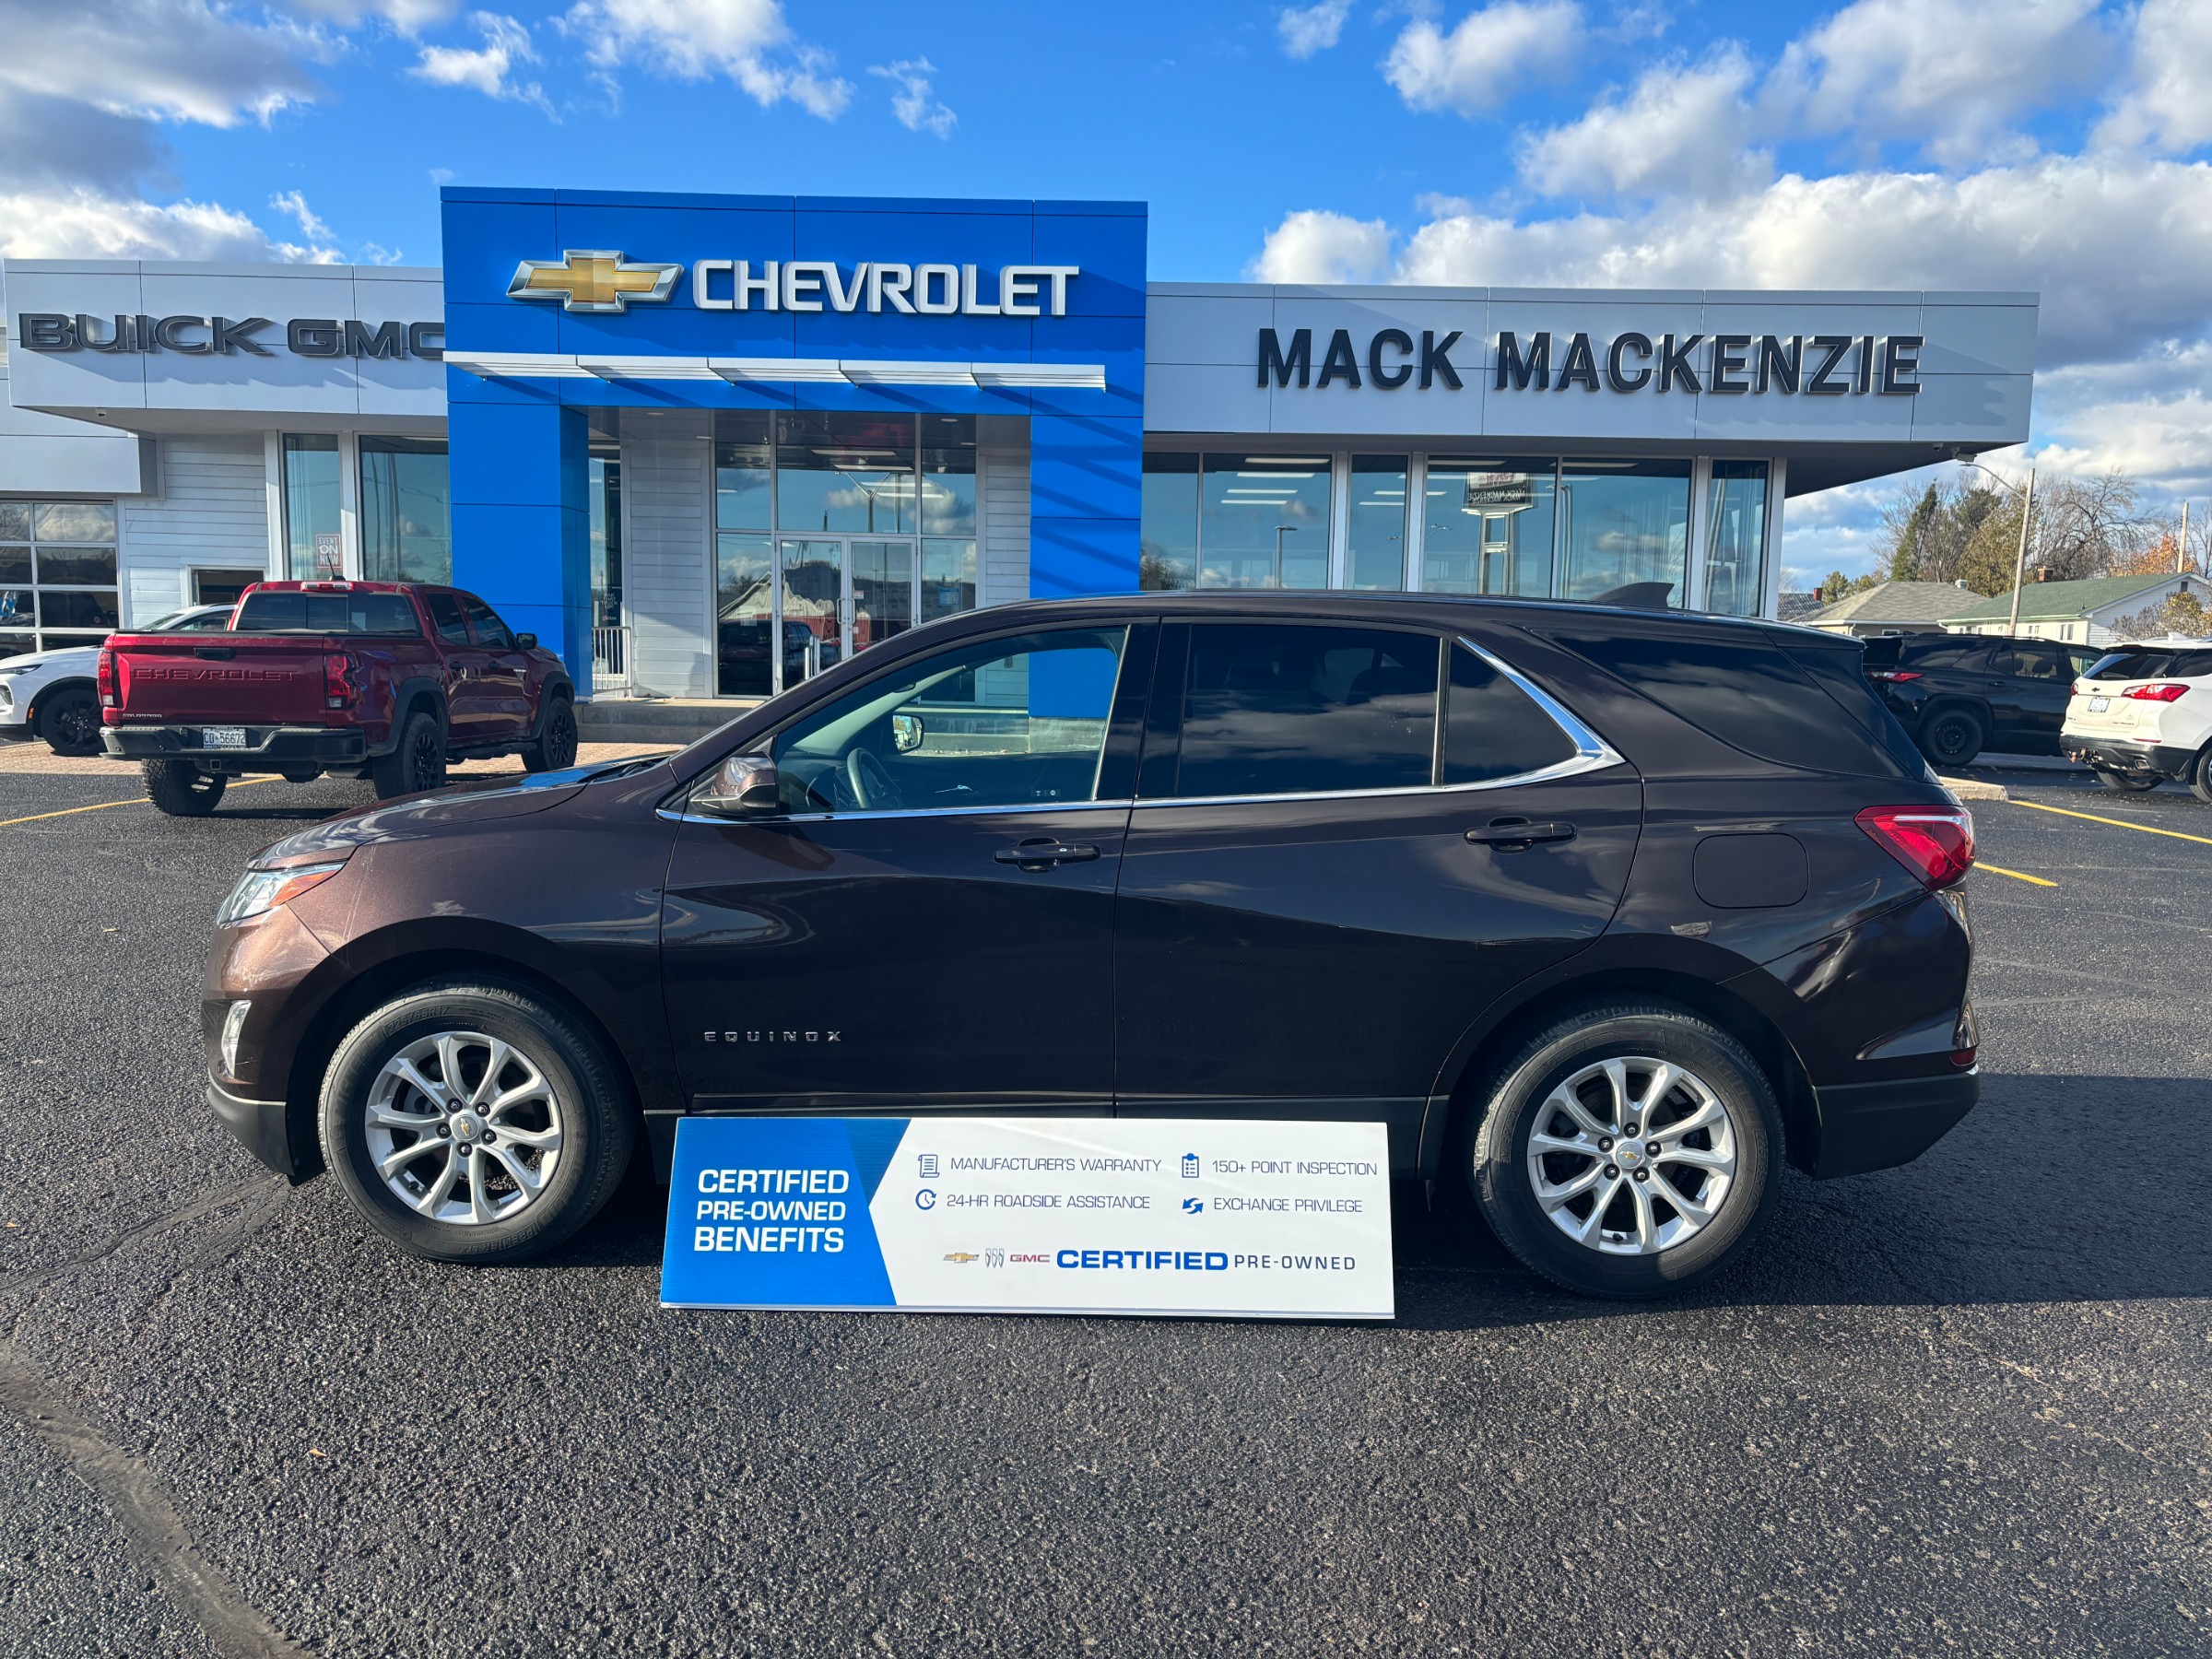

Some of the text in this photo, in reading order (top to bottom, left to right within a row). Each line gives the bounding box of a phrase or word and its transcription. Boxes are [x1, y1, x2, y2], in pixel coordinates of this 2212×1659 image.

[693, 259, 1080, 316] CHEVROLET
[18, 312, 275, 354] BUICK
[1256, 327, 1924, 395] MACK MACKENZIE
[319, 545, 338, 554] ON
[133, 668, 298, 681] CHEVROLET
[703, 1030, 841, 1042] EQUINOX
[950, 1158, 1161, 1171] MANUFACTURER'S WARRANTY
[1212, 1160, 1378, 1175] 150+ POINT INSPECTION
[698, 1169, 850, 1194] CERTIFIED
[696, 1200, 846, 1220] PRE-OWNED
[947, 1194, 1150, 1209] 24-HR ROADSIDE ASSISTANCE
[1214, 1198, 1363, 1213] EXCHANGE PRIVILEGE
[694, 1226, 844, 1253] BENEFITS
[1009, 1250, 1356, 1271] GMC CERTIFIED PRE-OWNED
